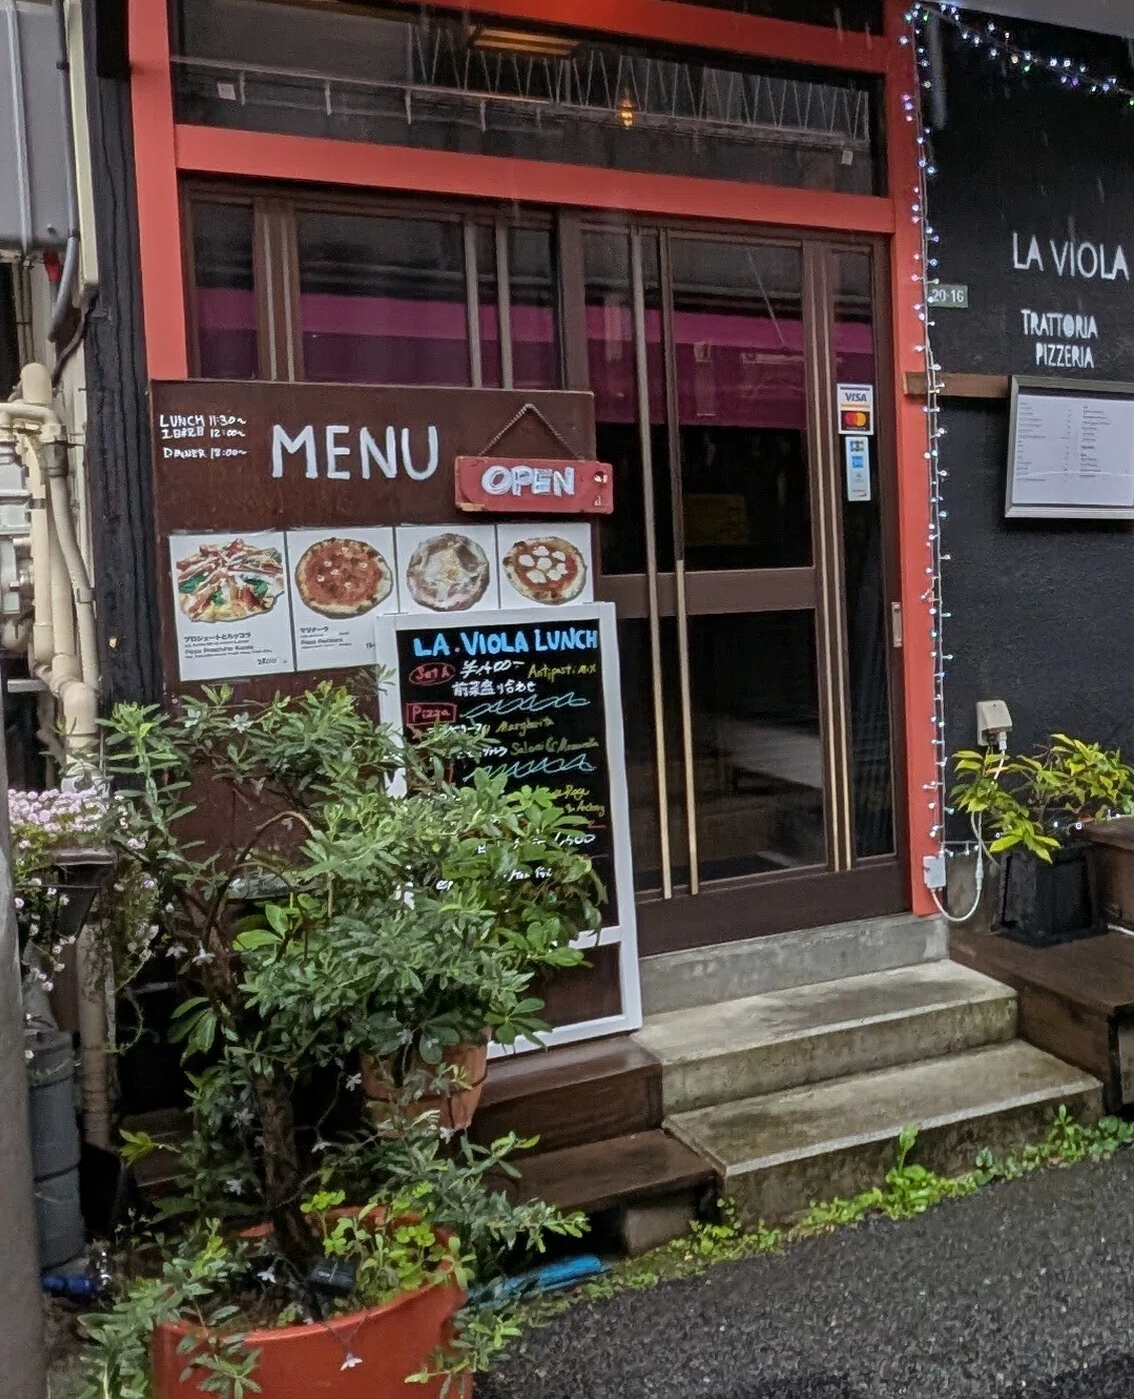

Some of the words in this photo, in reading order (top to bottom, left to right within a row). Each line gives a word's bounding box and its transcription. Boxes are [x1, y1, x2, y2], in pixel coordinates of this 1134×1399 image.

[1012, 232, 1045, 272] LA
[1050, 239, 1130, 282] VIOLA
[1020, 308, 1099, 339] TRATTORIA
[1035, 342, 1095, 369] PIZZERIA
[845, 392, 868, 402] VISA
[160, 414, 205, 428] LUNCH
[271, 423, 439, 481] MENU
[481, 465, 575, 497] OPEN
[534, 627, 598, 652] LUNCH
[412, 705, 451, 723] Pizza
